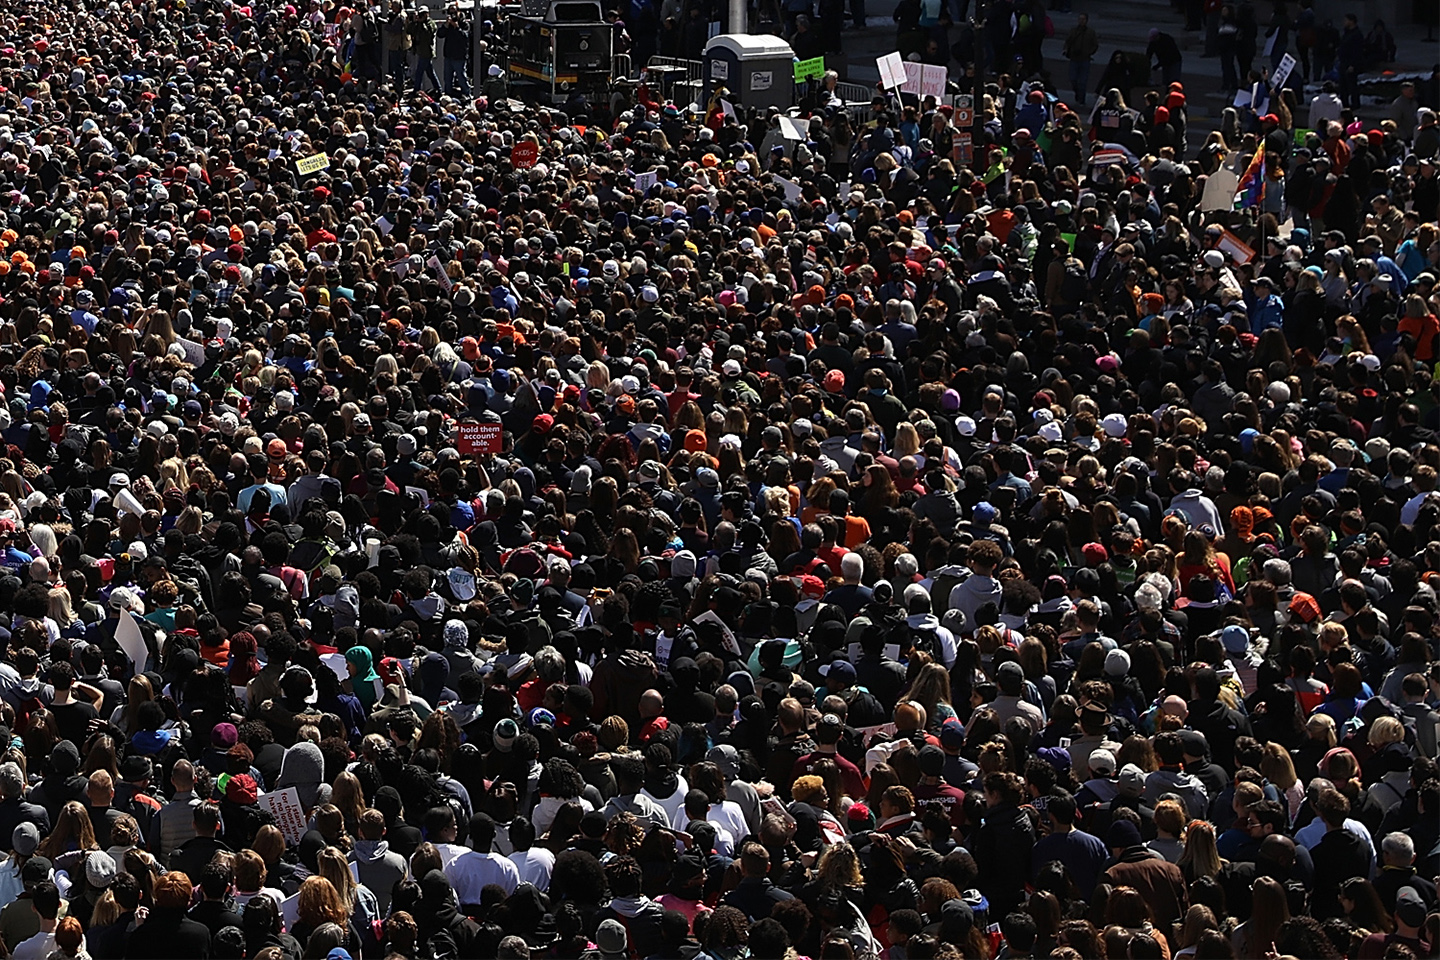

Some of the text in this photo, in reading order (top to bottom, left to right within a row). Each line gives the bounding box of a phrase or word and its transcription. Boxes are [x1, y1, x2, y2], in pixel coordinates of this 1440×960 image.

[480, 425, 500, 433] them
[268, 796, 278, 815] have
[285, 805, 295, 825] those
[277, 802, 283, 812] no
[280, 813, 292, 835] longer
[293, 809, 304, 828] stand
